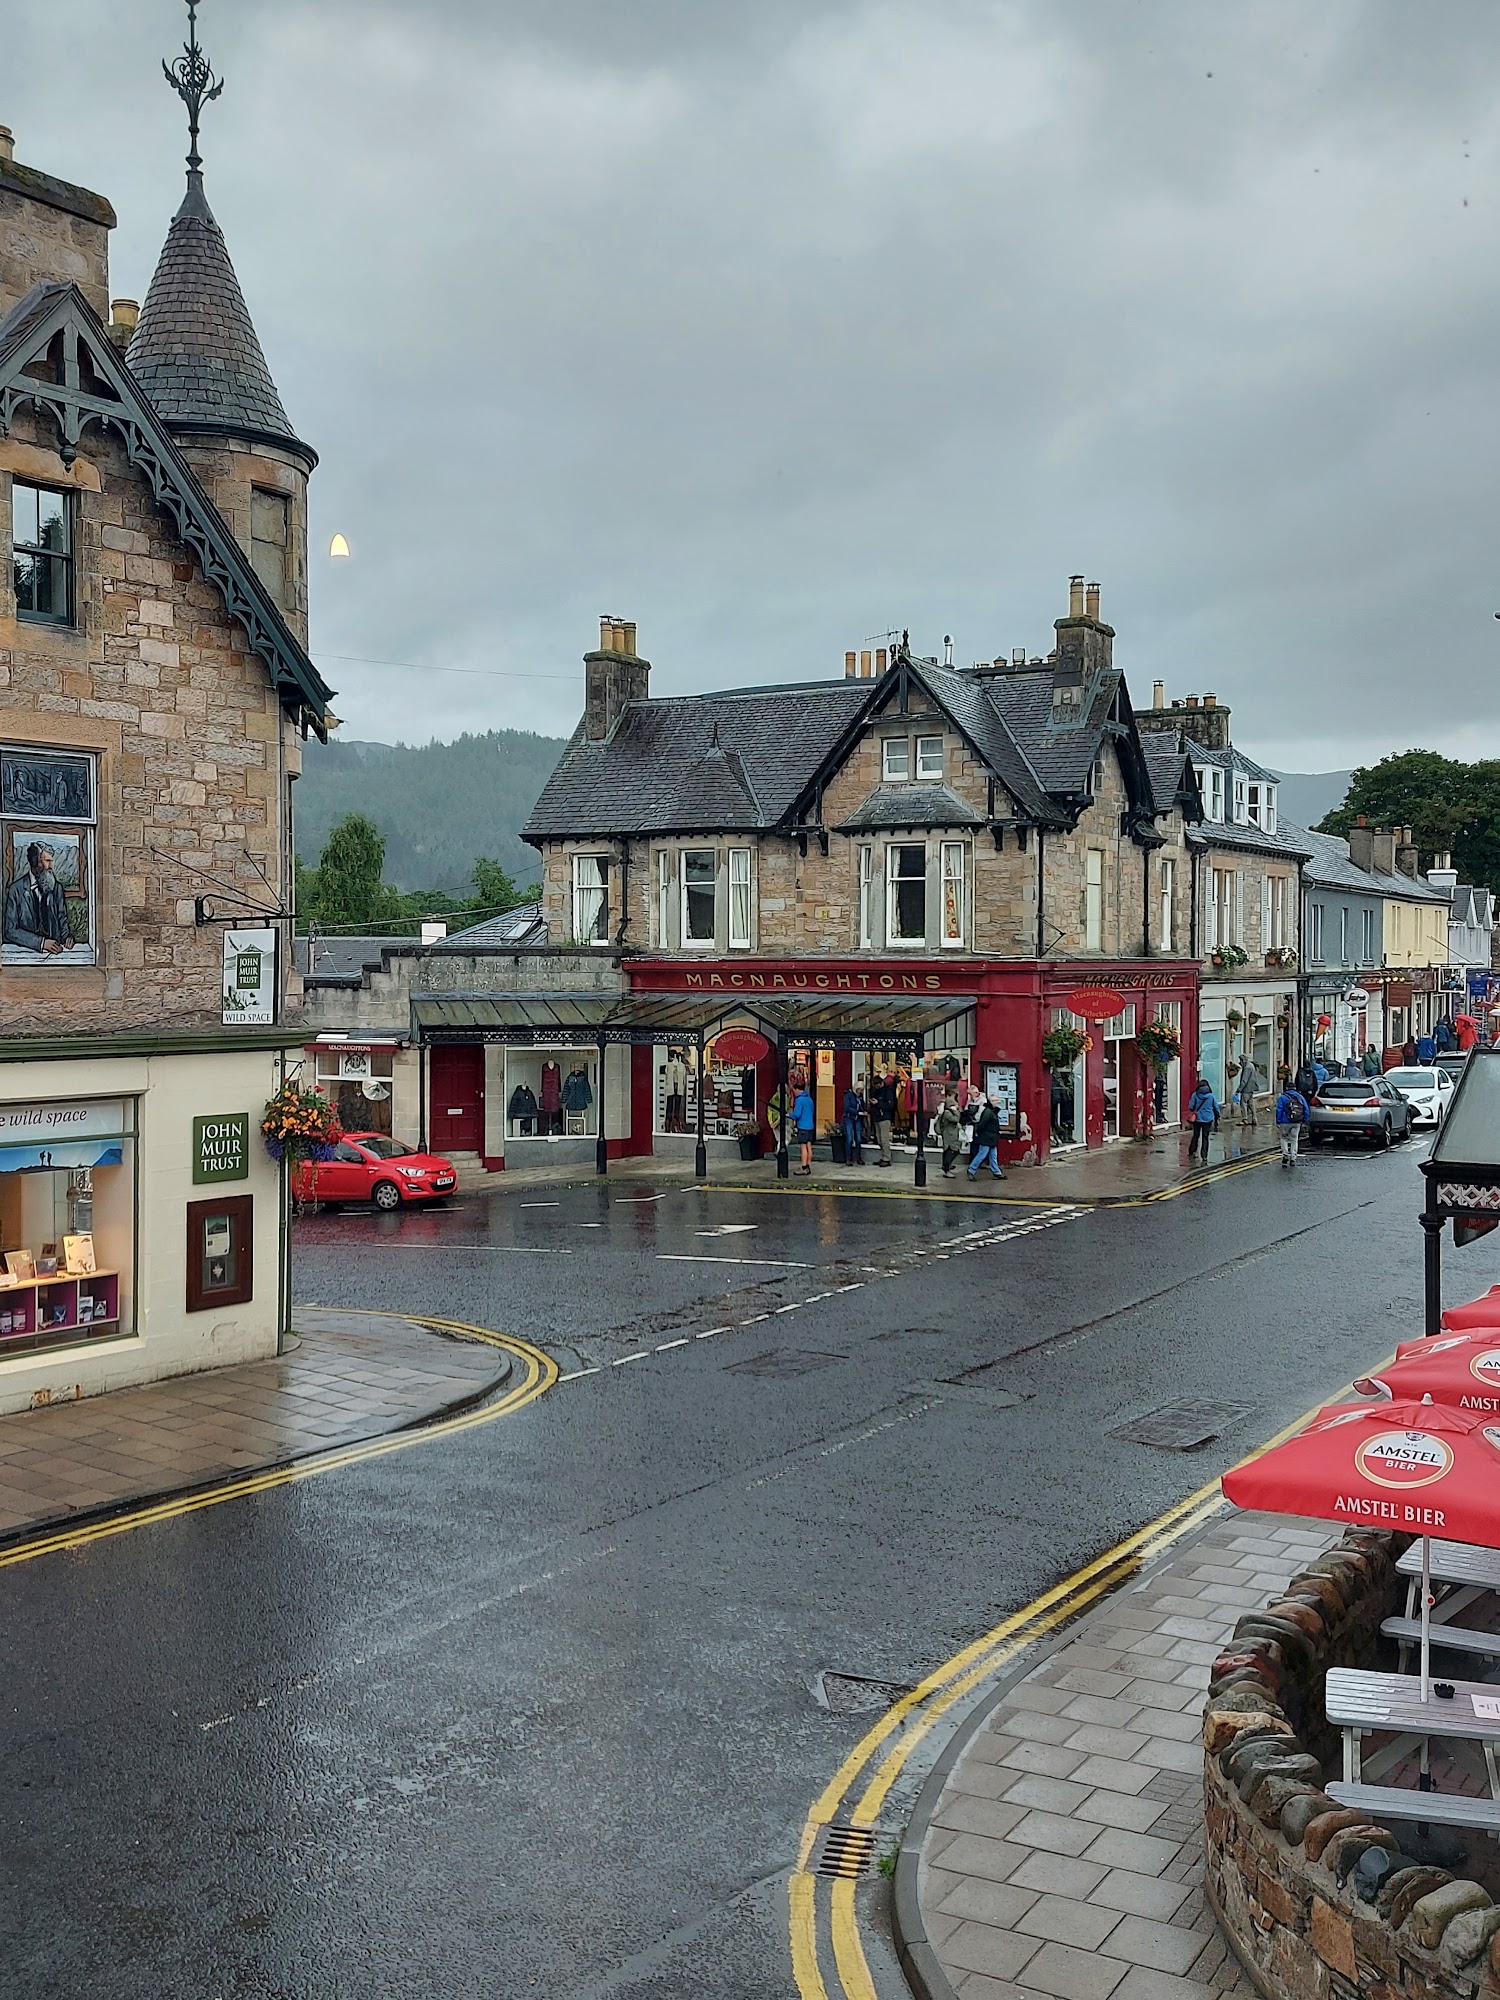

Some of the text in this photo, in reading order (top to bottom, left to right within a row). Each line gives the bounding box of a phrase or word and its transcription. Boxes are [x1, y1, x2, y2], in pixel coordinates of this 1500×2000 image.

[239, 957, 259, 967] JOHN
[239, 966, 259, 976] MUIR
[239, 976, 259, 984] TRUST
[685, 973, 941, 989] MACNAUGHTONS
[225, 1013, 271, 1022] WILD SPACE
[9, 1110, 43, 1127] wild
[46, 1110, 87, 1127] space
[200, 1121, 243, 1144] JOHN
[200, 1139, 243, 1157] MUIR
[200, 1155, 243, 1172] TRUST
[1372, 1445, 1440, 1464] AMSTEL
[1385, 1459, 1417, 1472] BIER
[1333, 1495, 1446, 1527] AMSTEL BIER
